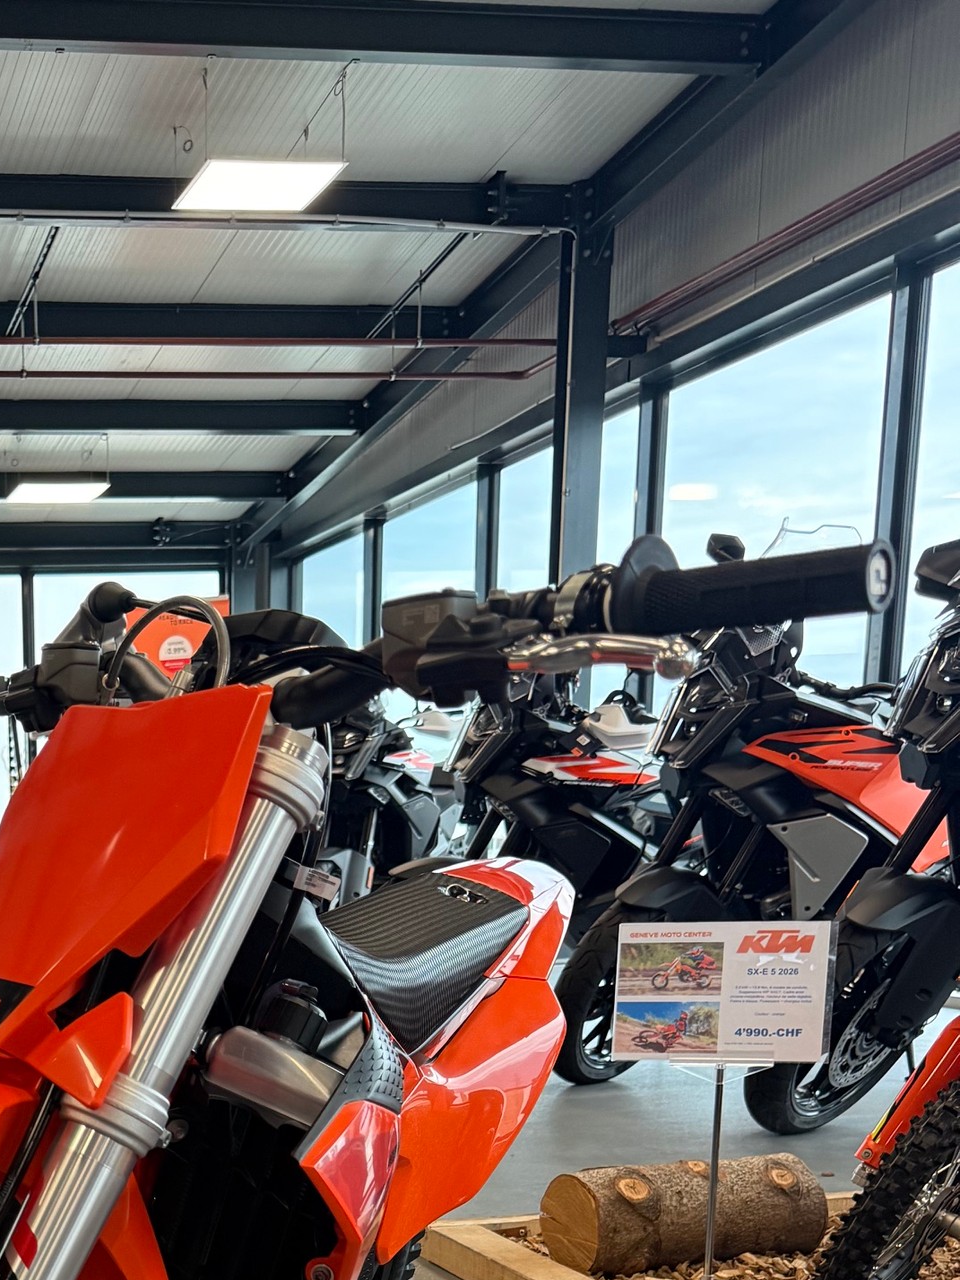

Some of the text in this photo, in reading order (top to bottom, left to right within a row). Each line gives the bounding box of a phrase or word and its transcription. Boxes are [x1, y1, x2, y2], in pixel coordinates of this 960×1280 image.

[824, 759, 883, 767] SUPER
[736, 930, 815, 954] KTM
[747, 968, 799, 976] SX-E 5 2026
